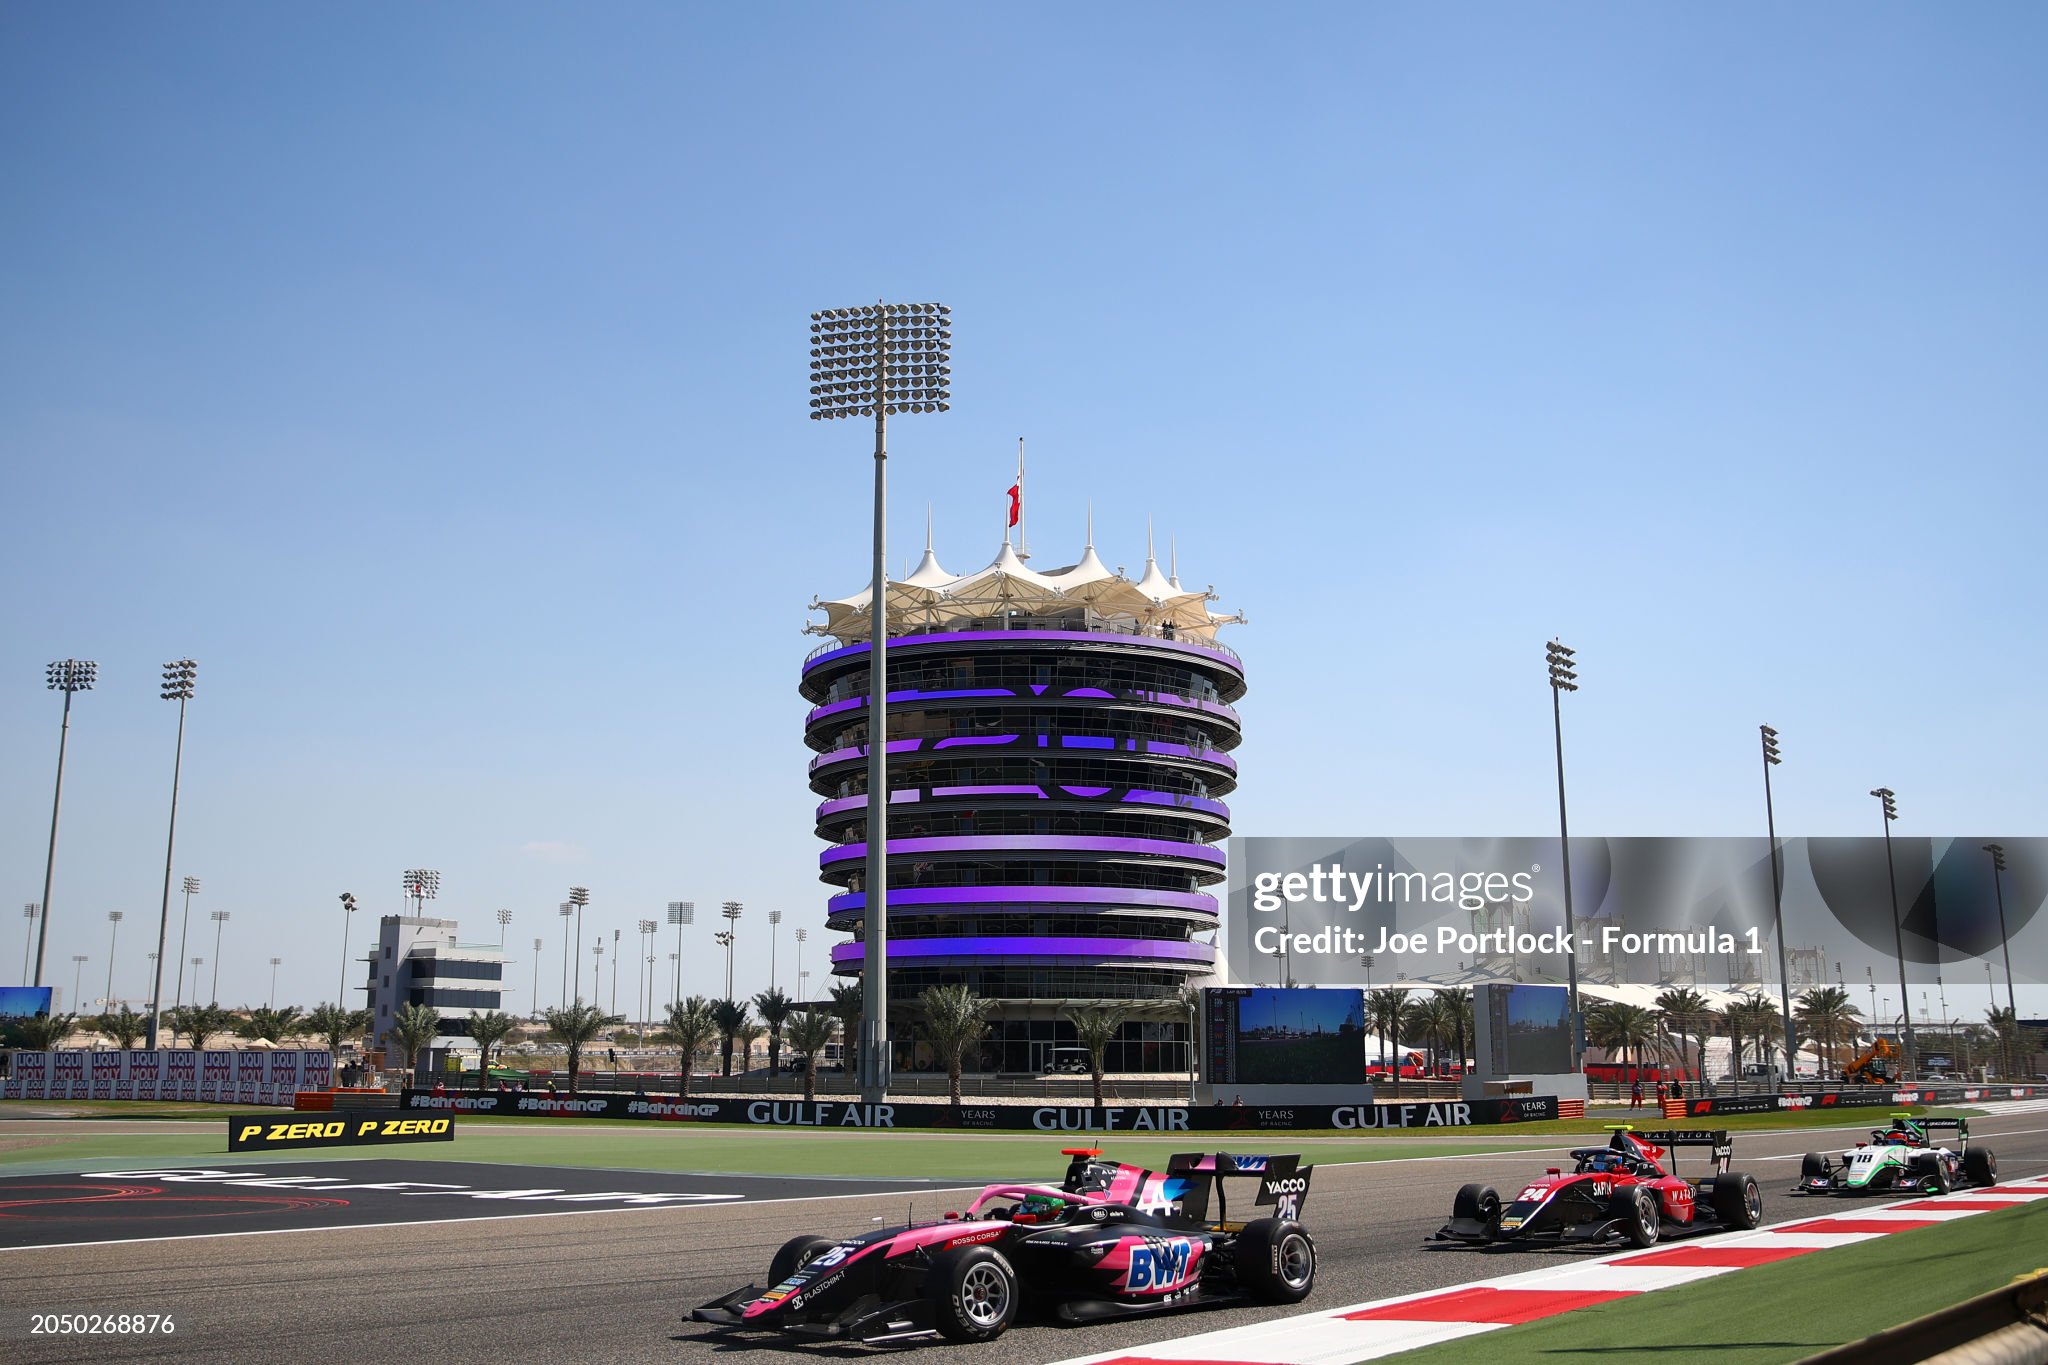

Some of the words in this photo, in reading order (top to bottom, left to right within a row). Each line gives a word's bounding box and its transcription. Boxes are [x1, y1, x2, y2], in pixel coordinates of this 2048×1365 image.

[18, 1054, 44, 1067] LIQUI
[56, 1054, 82, 1067] LIQUI
[93, 1053, 120, 1067] LIQUI
[131, 1052, 158, 1066] LIQUI
[170, 1052, 195, 1067] LIQUI
[206, 1052, 230, 1067] LIQUI
[240, 1053, 262, 1068] LIQUI
[273, 1053, 296, 1068] LIQUI
[306, 1053, 329, 1068] LIQUI
[18, 1068, 45, 1080] MOLY
[55, 1068, 82, 1080] MOLY
[92, 1068, 120, 1080] MOLY
[130, 1068, 158, 1080] MOLY
[169, 1068, 195, 1080] MOLY
[205, 1068, 230, 1081] MOLY
[240, 1069, 262, 1082] MOLY
[272, 1070, 296, 1083] MOLY
[304, 1070, 329, 1084] MOLY
[410, 1095, 498, 1110] #BahrainGP
[518, 1098, 607, 1112] #BahrainGP
[628, 1101, 719, 1116] #BahrainGP
[1521, 1101, 1546, 1111] YEARS
[747, 1101, 834, 1125] GULF
[840, 1104, 895, 1128] AIR
[961, 1110, 996, 1119] YEARS
[1032, 1108, 1124, 1130] GULF
[1132, 1108, 1190, 1131] AIR
[1258, 1110, 1294, 1120] YEARS
[1331, 1105, 1417, 1130] GULF
[1425, 1103, 1472, 1127] AIR
[239, 1125, 262, 1142] P
[266, 1122, 346, 1140] ZERO
[358, 1122, 378, 1136] P
[381, 1119, 450, 1136] ZERO
[1714, 1146, 1731, 1156] YACCO
[1266, 1178, 1306, 1194] YACCO
[1517, 1188, 1548, 1201] 24
[1278, 1194, 1298, 1220] 25
[952, 1236, 976, 1246] ROSSO
[812, 1246, 855, 1266] 25
[1124, 1238, 1192, 1292] BWT
[804, 1270, 846, 1301] PLASTCHIM-T
